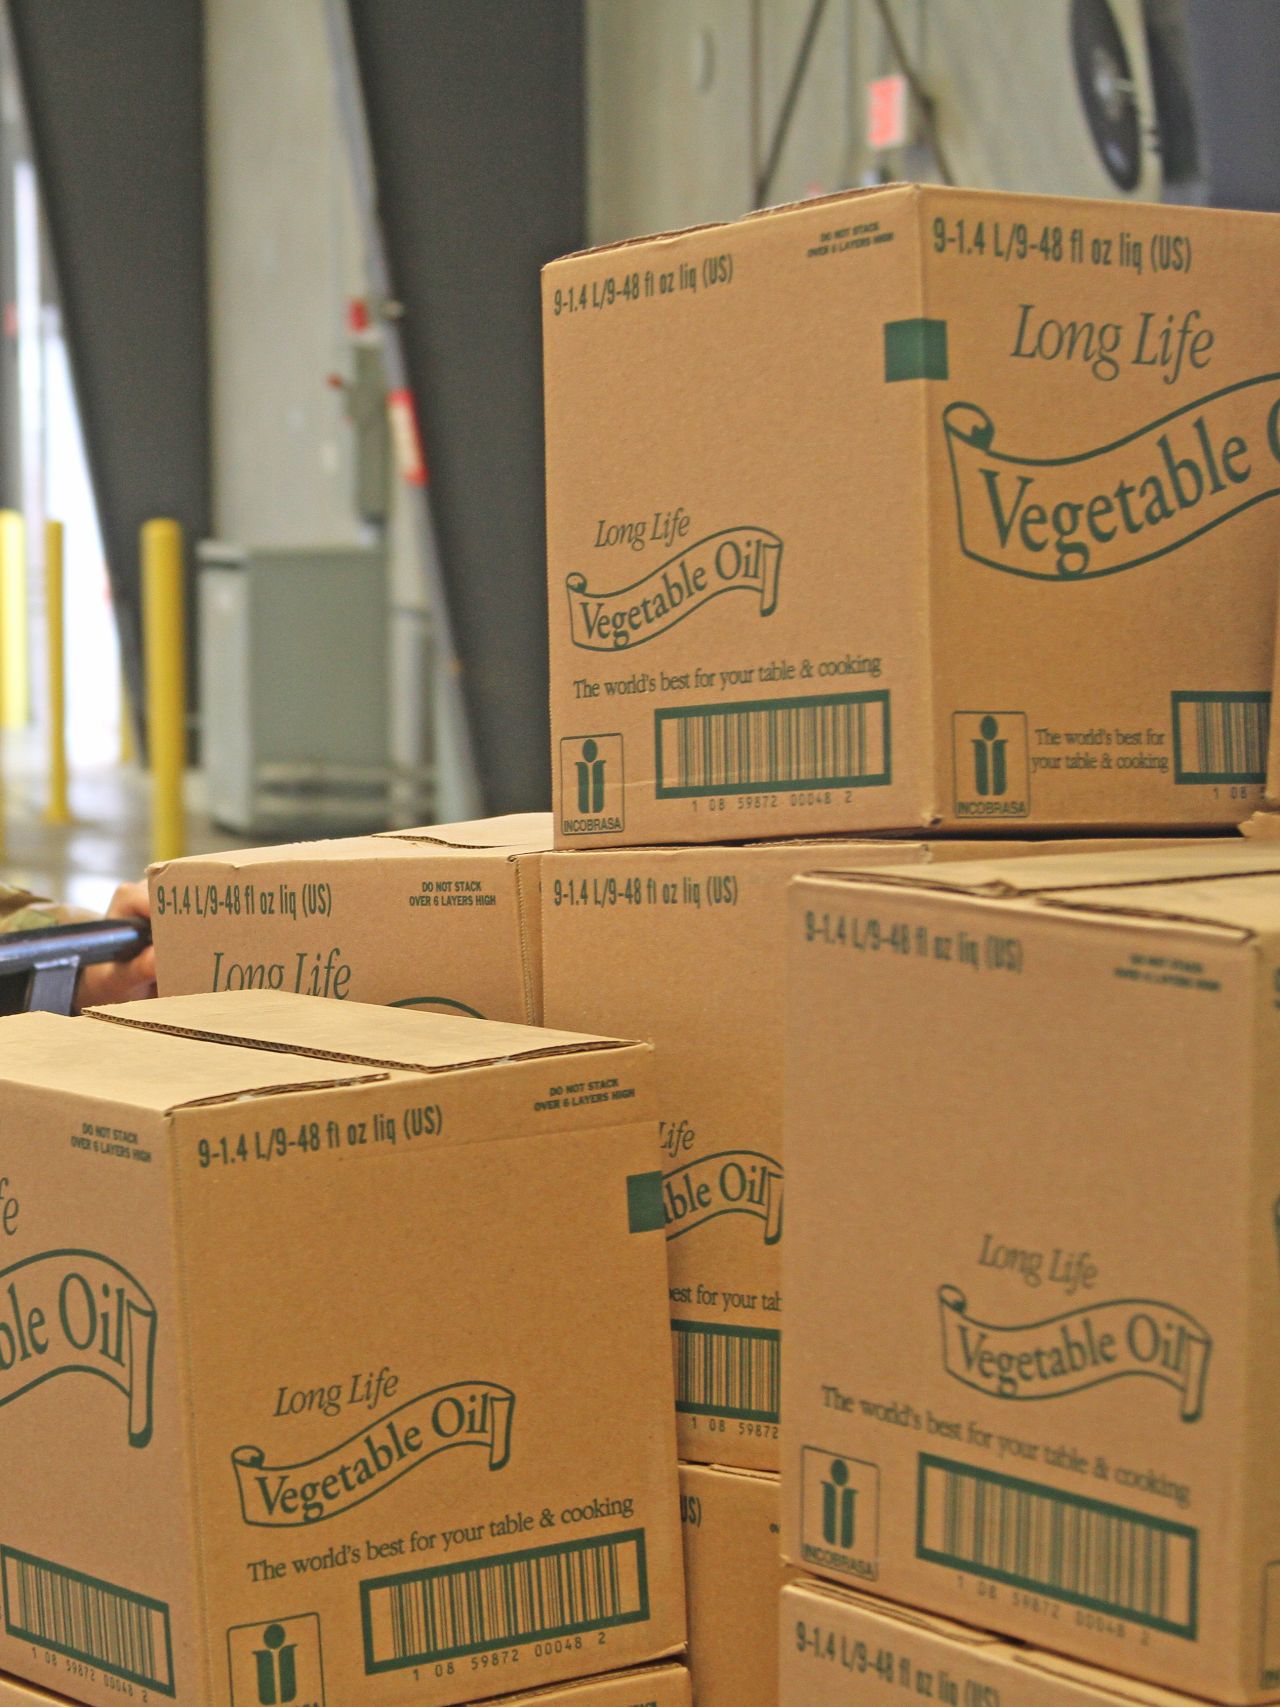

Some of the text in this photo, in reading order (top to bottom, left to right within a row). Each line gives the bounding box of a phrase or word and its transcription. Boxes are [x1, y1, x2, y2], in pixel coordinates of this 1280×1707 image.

[933, 217, 986, 255] 9-1.4
[994, 222, 1062, 262] L/9-48
[1069, 228, 1084, 263] fl
[1091, 238, 1112, 266] oz
[1120, 232, 1143, 275] liq
[1151, 234, 1192, 273] (US)
[554, 254, 734, 316] 9-1.4 L/9-48 fl oz liq (US)
[1010, 303, 1214, 385] Long Life
[978, 415, 1252, 577] Vegetable
[594, 507, 691, 551] Long Life
[579, 539, 762, 649] Vegetable Oil
[574, 654, 882, 699] The world's best for your table & cooking
[1035, 728, 1165, 746] The world's best for
[1031, 753, 1169, 774] your table & cooking
[564, 817, 621, 832] INCOBRASA
[957, 802, 1025, 815] INCOBRASA
[158, 883, 332, 920] 9-1.4 L/9-48 fl oz liq (US)
[409, 895, 431, 907] OVER
[441, 895, 473, 907] LAYERS
[475, 895, 496, 907] HIGH
[422, 881, 482, 892] DO NOT STACK
[554, 875, 738, 909] 9-1.4 L/9-48 fl oz liq (US)
[534, 1099, 560, 1112] OVER
[572, 1092, 609, 1106] LAYERS
[611, 1089, 635, 1100] HIGH
[549, 1078, 619, 1096] DO NOT STACK
[198, 1105, 443, 1168] 9-1.4 L/9-48 fl oz liq (US)
[720, 1162, 767, 1206] Oil
[59, 1272, 126, 1367] Oil
[697, 1284, 718, 1306] for
[722, 1291, 757, 1312] your
[273, 1366, 399, 1418] Long Life
[709, 1418, 725, 1432] 08
[739, 1422, 778, 1439] 59872
[255, 1394, 489, 1521] Vegetable Oil
[247, 1496, 634, 1583] The world's best for your table & cooking
[434, 1663, 455, 1679] 08
[470, 1649, 520, 1671] 59872
[534, 1636, 583, 1658] 00048
